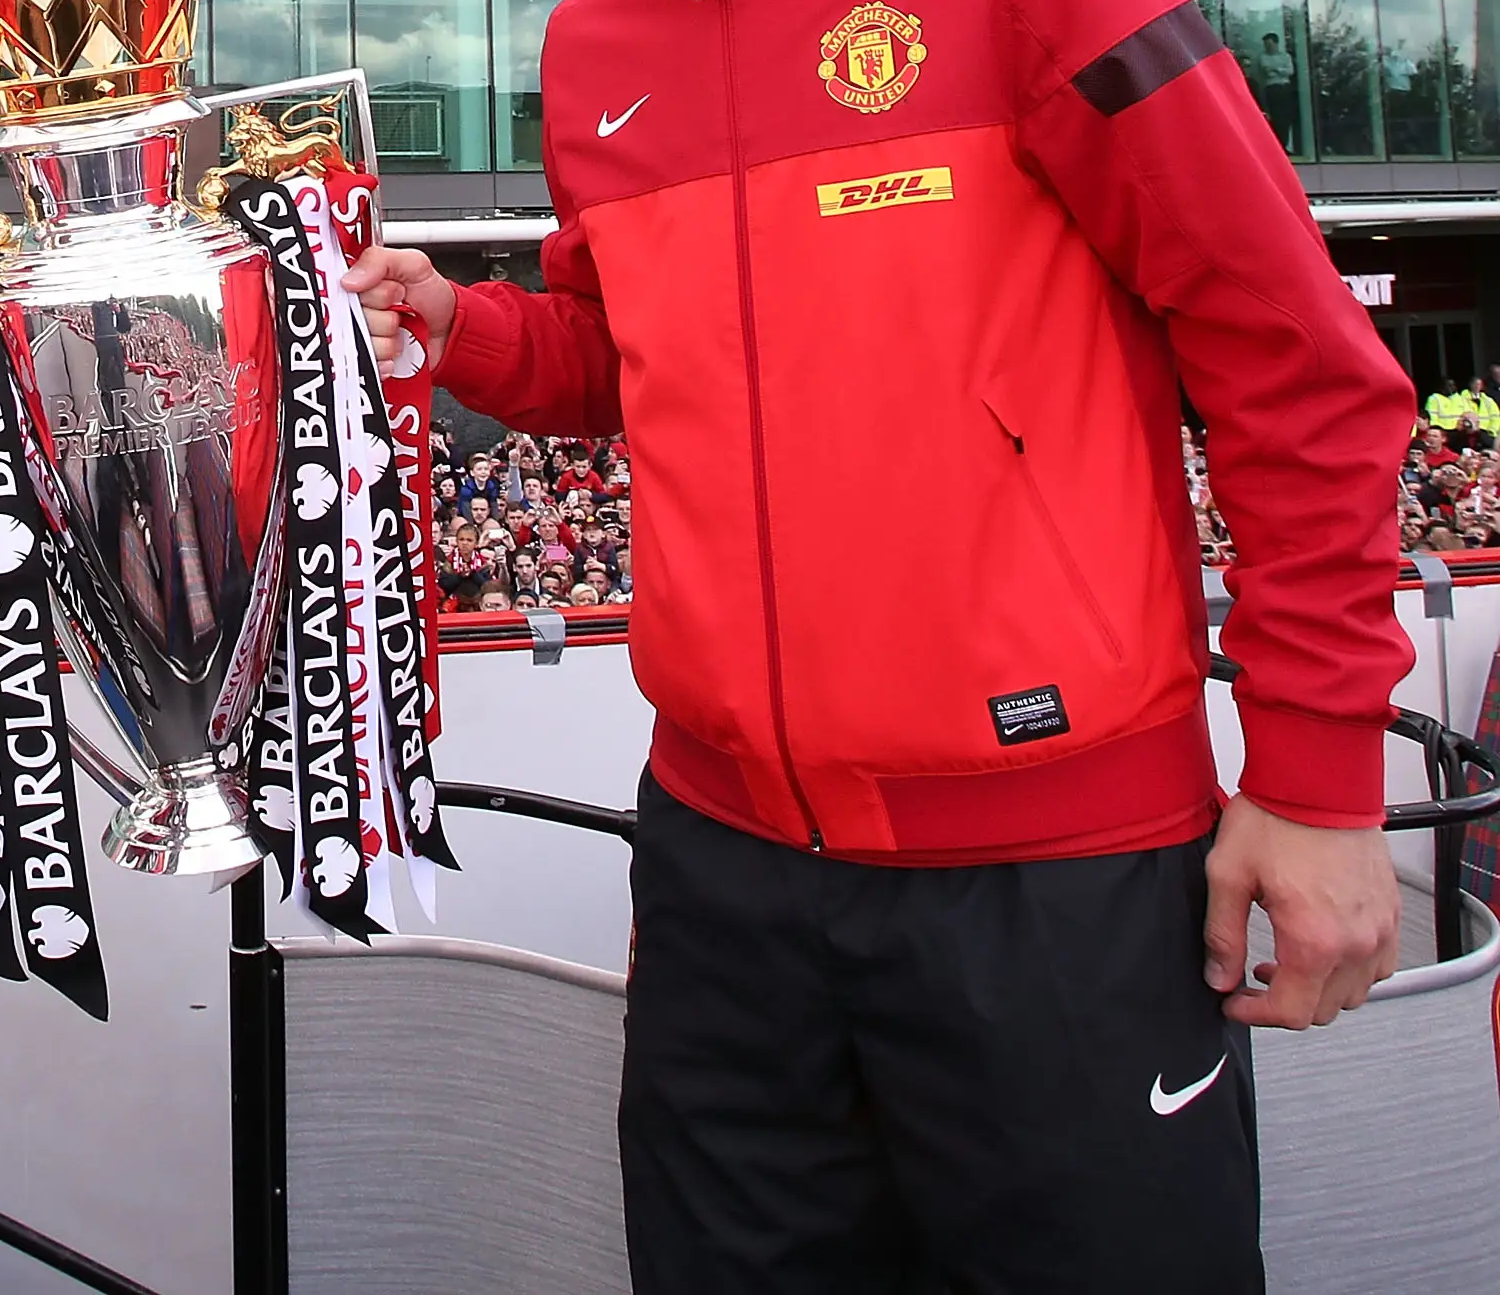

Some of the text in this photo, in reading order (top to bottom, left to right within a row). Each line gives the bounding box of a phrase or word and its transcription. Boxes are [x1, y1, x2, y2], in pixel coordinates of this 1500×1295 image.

[828, 9, 914, 53] MANCHESTER
[843, 82, 905, 105] UNITED
[839, 175, 932, 209] DHL
[1340, 274, 1396, 305] XIT
[240, 190, 329, 449] BARCLAYS
[54, 398, 262, 460] PREMIER LEAGUE
[372, 506, 425, 771] BARCLAYS
[298, 542, 349, 824] BARCLAYS
[997, 693, 1052, 710] AUTHENTIC
